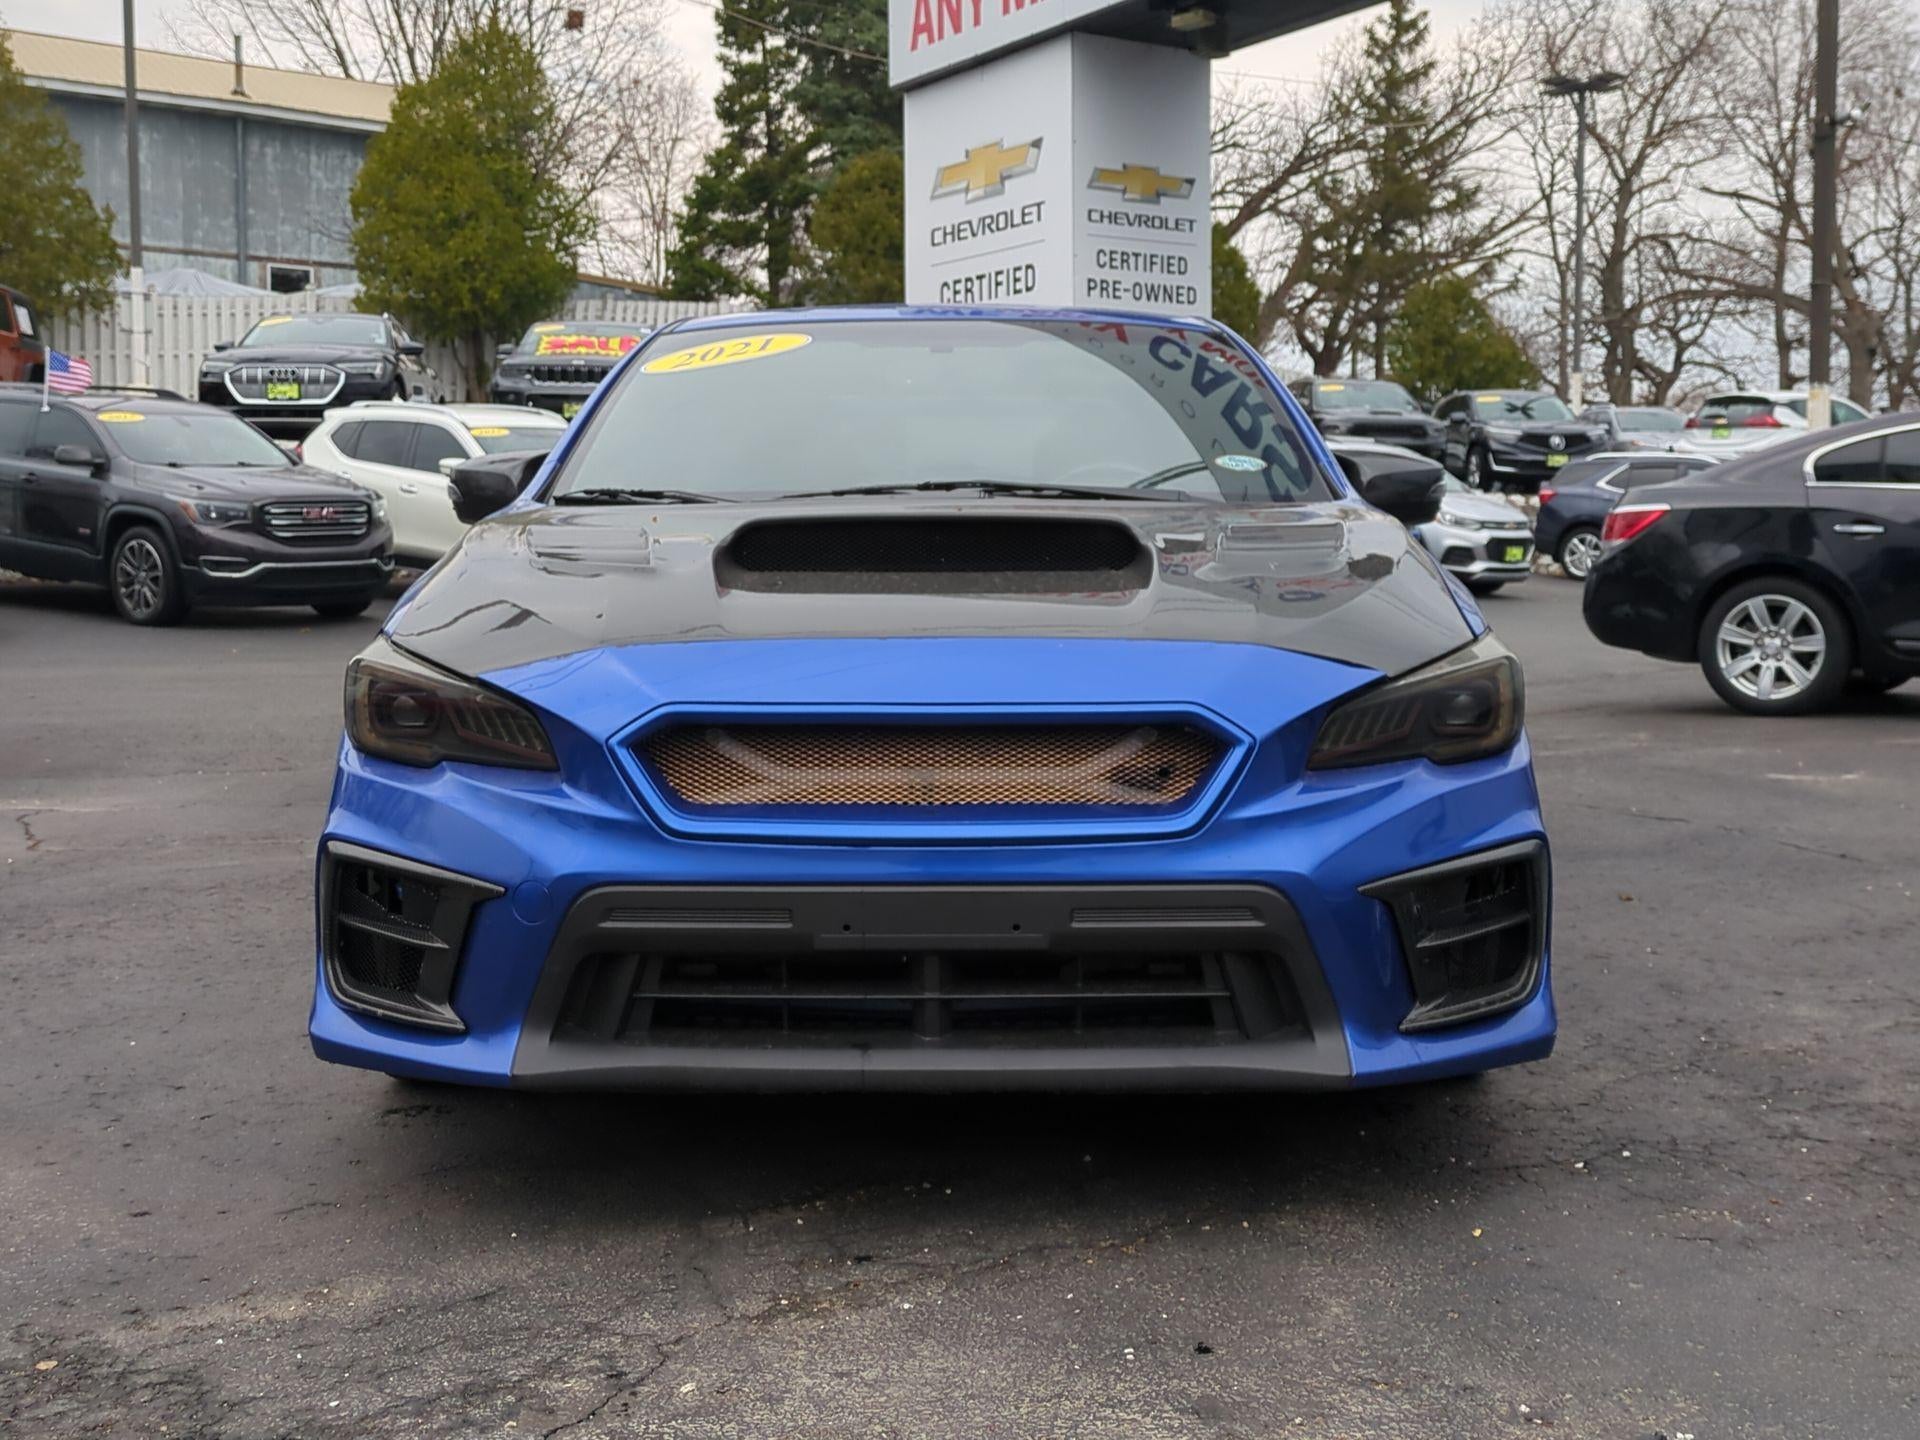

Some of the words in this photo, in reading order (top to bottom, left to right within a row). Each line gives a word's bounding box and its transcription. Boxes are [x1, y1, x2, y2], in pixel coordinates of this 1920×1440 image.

[931, 200, 1046, 247] CHEVROLET
[1087, 208, 1197, 233] CHEVROLET
[1096, 248, 1188, 276] CERTIFIED
[940, 263, 1036, 304] CERTIFIED
[1087, 277, 1197, 305] PRE-OWNED
[671, 337, 776, 369] 2021
